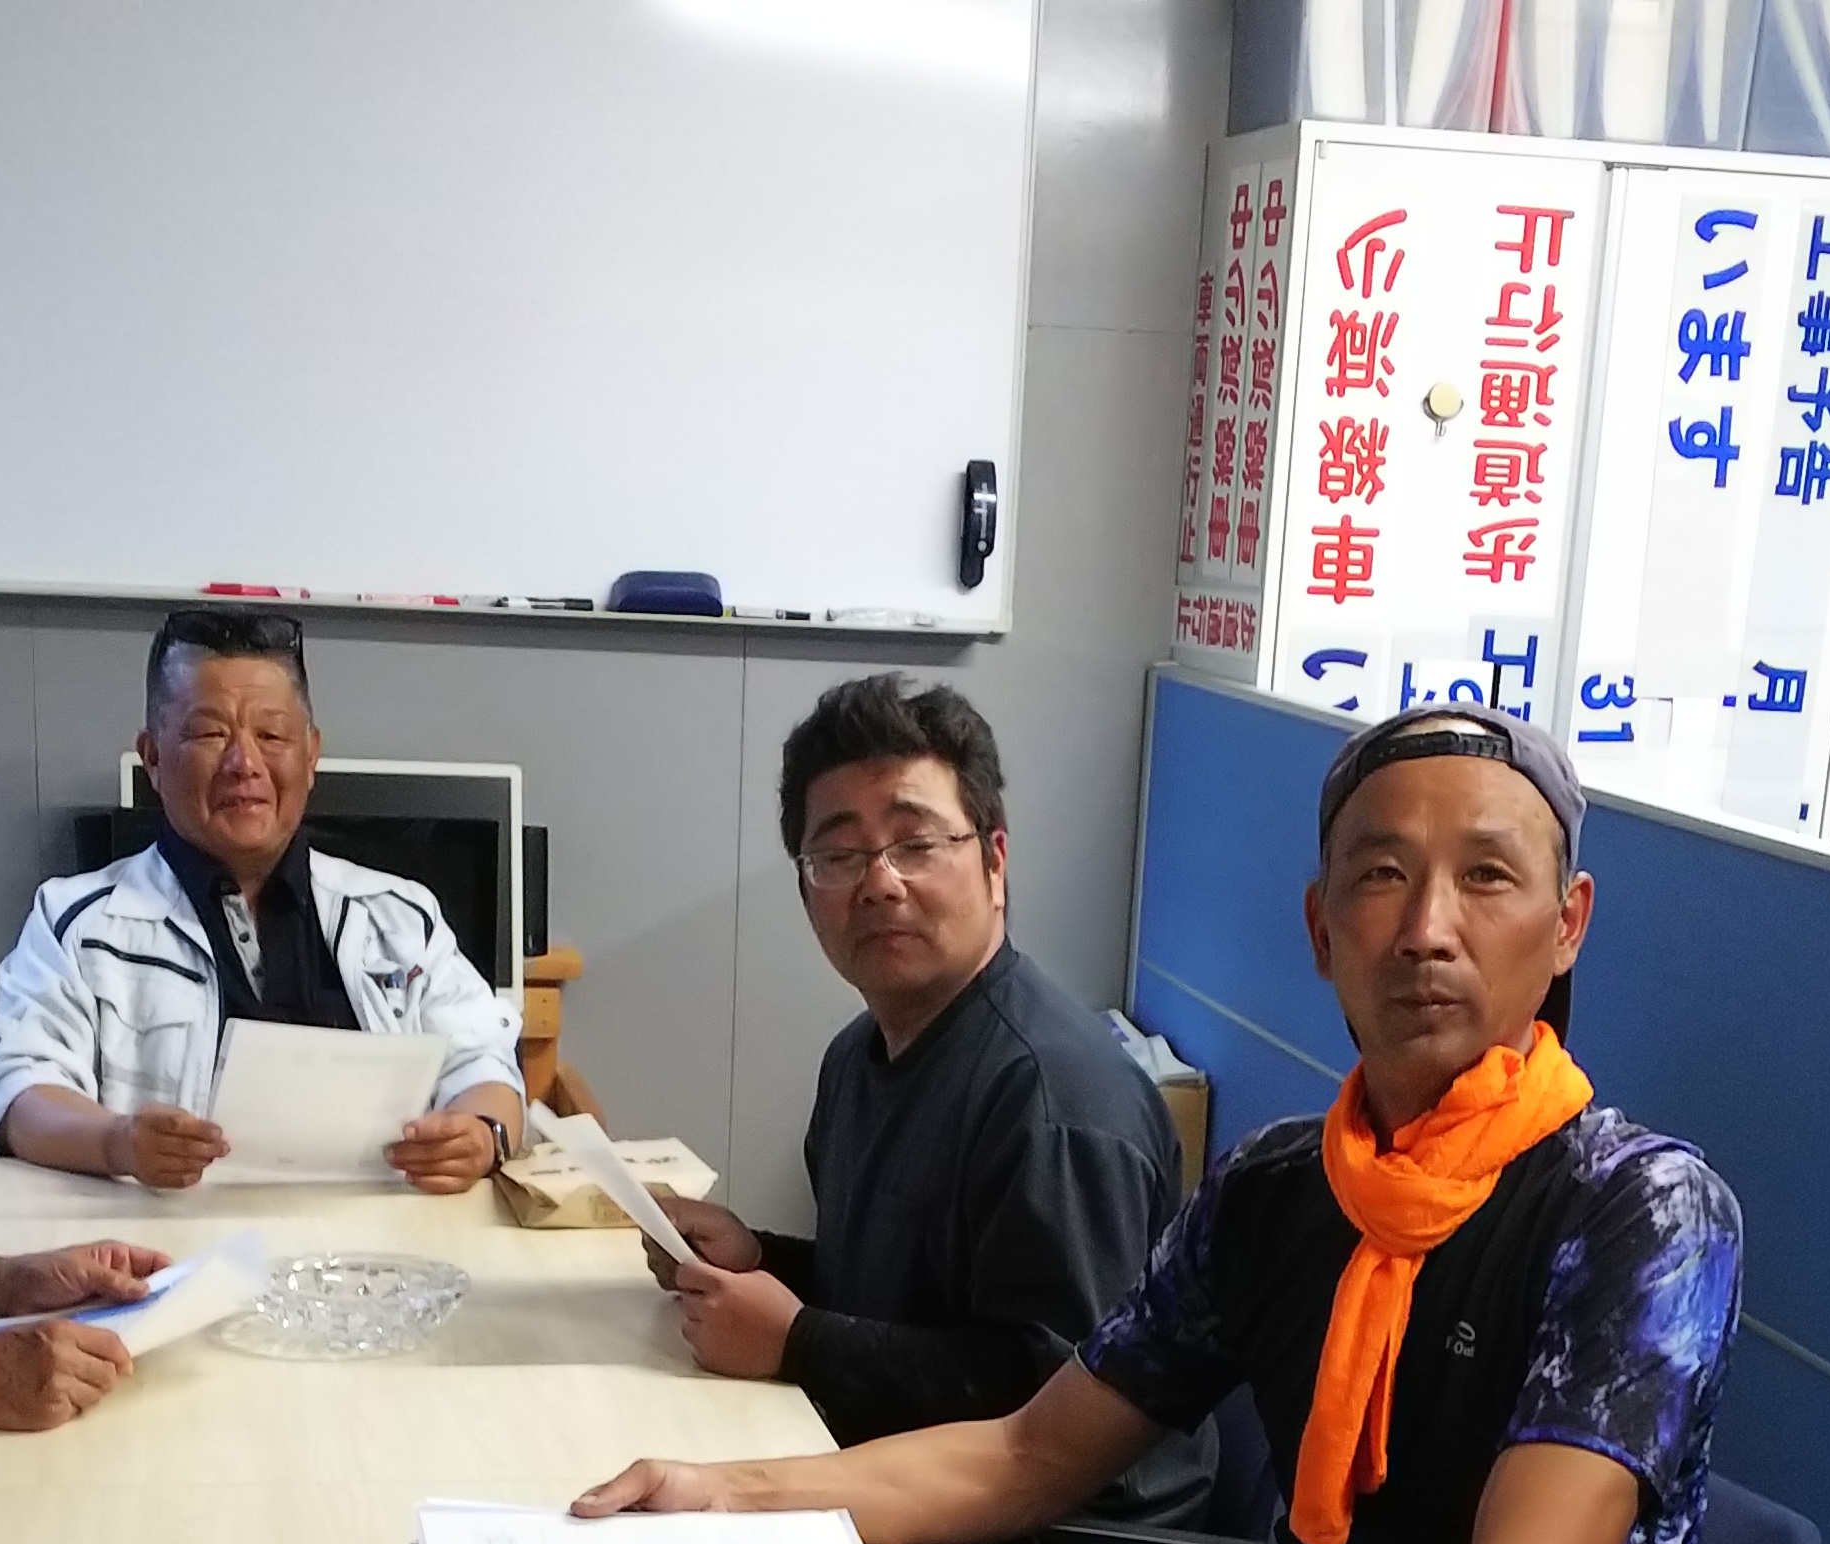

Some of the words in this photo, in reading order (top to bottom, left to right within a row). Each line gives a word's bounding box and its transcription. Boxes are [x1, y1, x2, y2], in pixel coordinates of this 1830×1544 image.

[1307, 208, 1408, 606] 車線減少
[1463, 204, 1575, 584] 歩道通行止
[1669, 209, 1759, 488] います
[1578, 674, 1637, 742] 31
